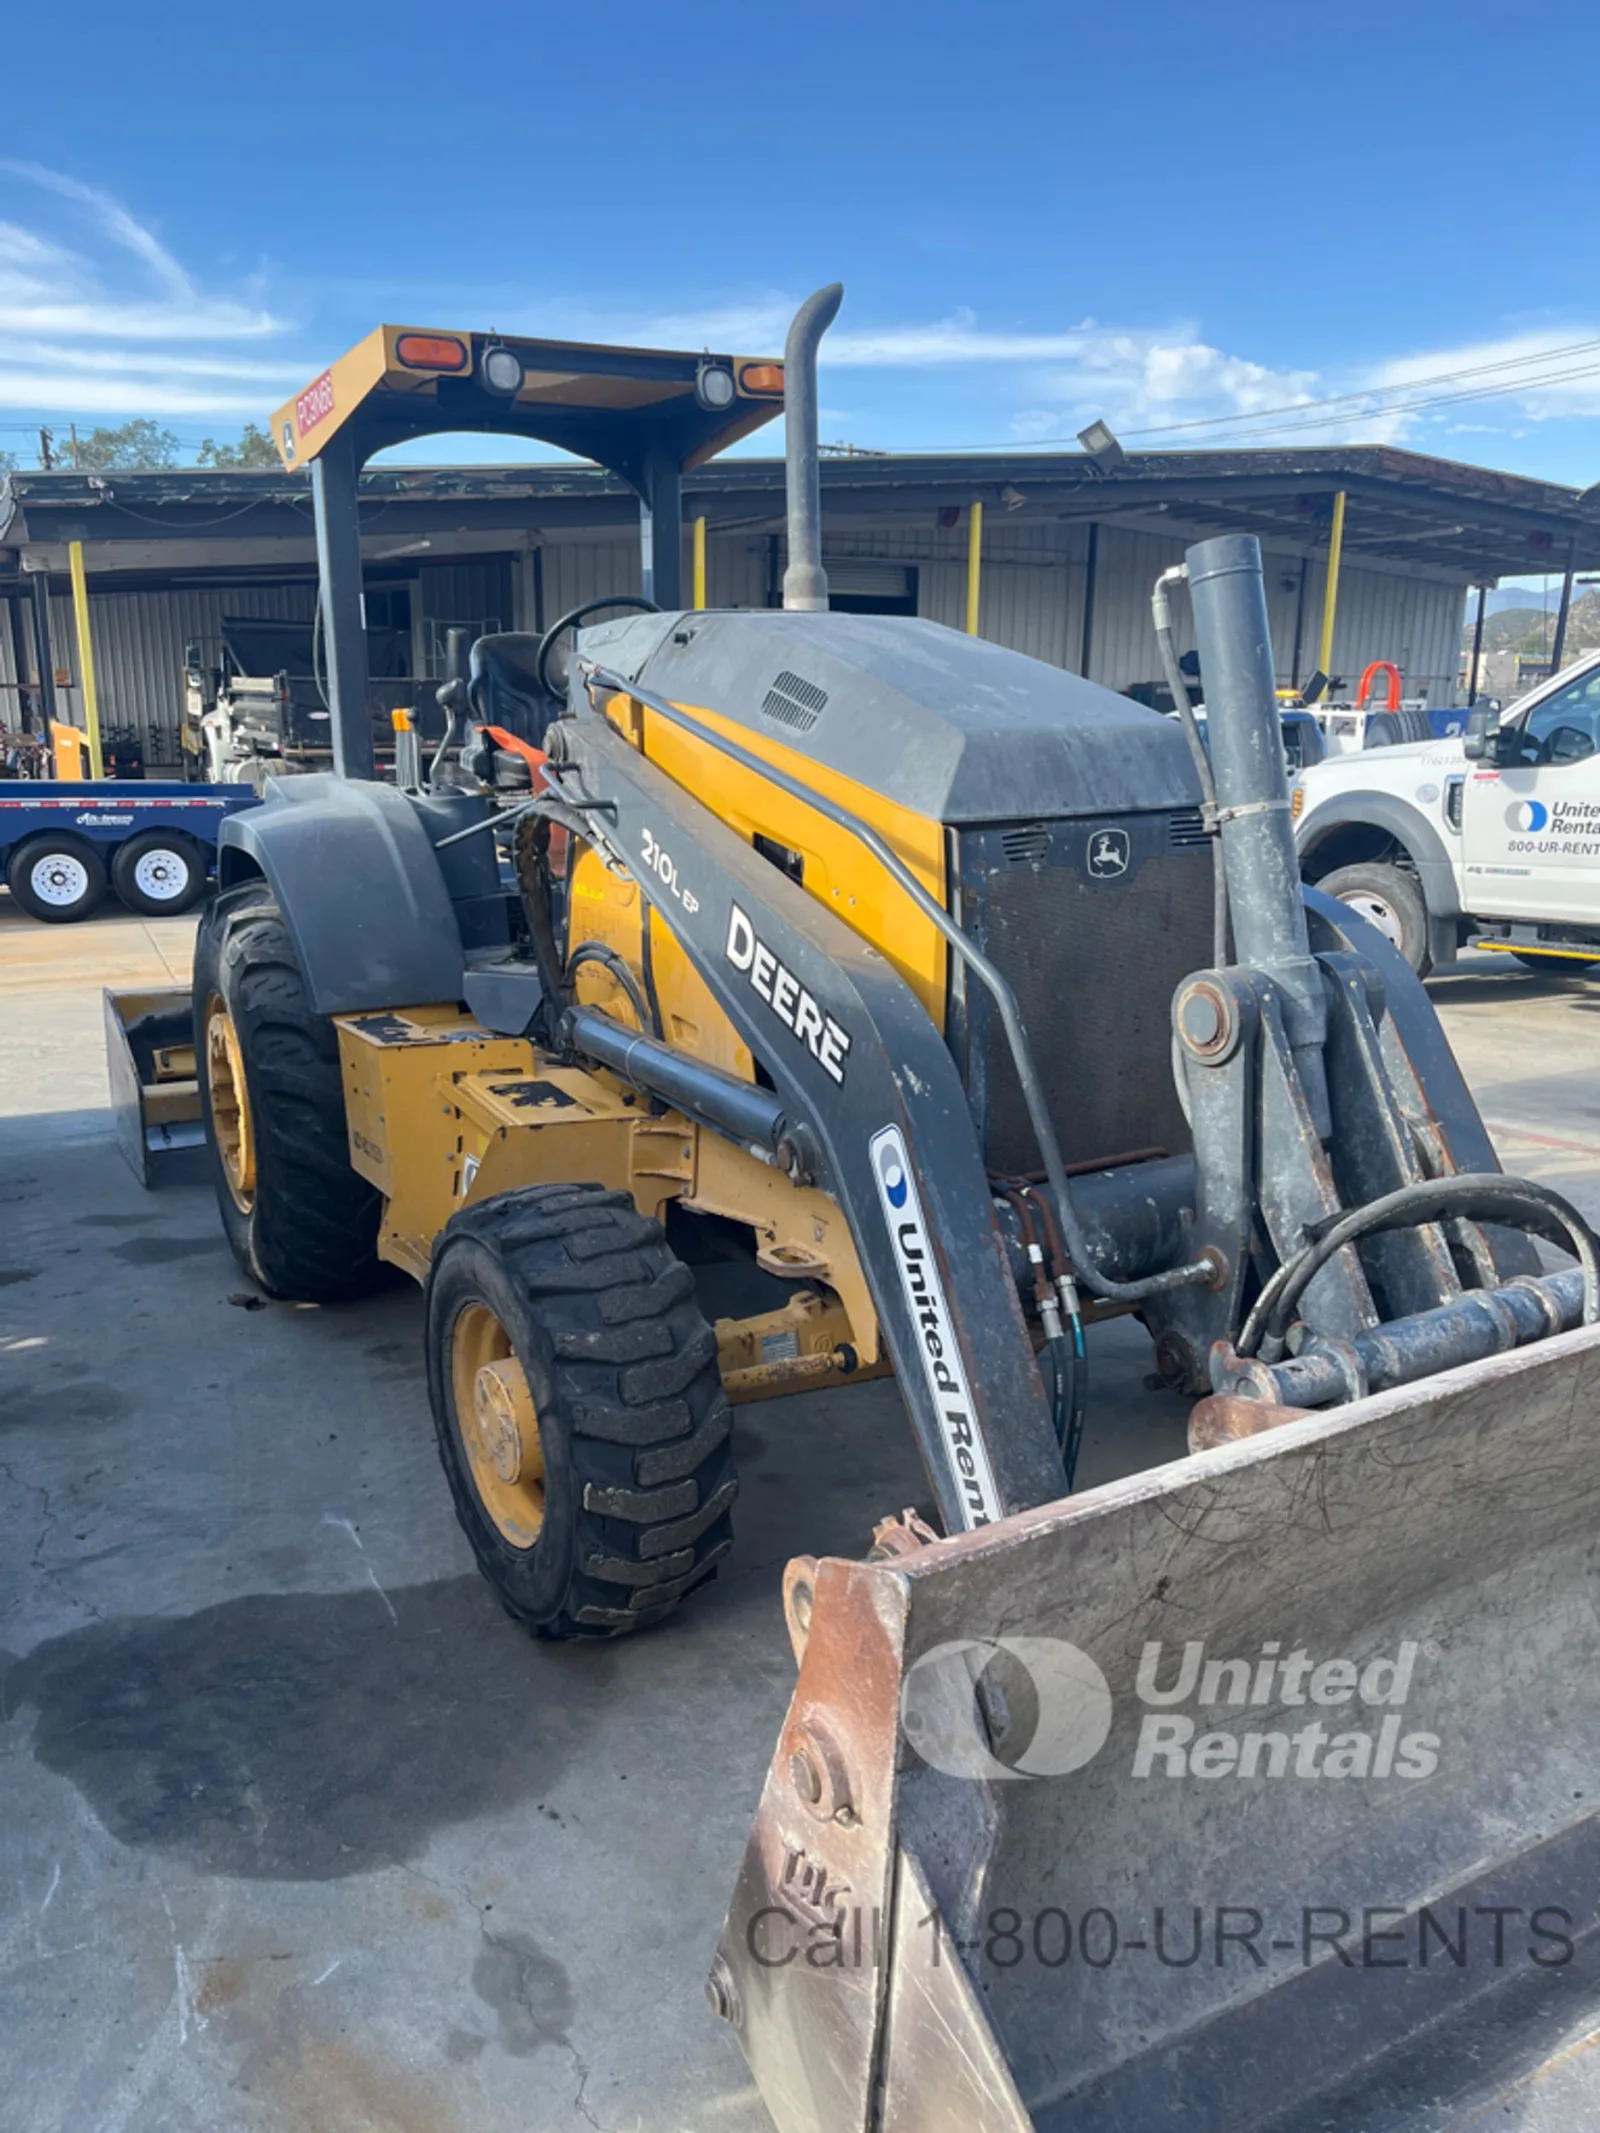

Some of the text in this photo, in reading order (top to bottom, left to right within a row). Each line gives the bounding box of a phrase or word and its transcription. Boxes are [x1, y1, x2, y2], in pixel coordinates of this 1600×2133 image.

[1552, 801, 1600, 817] Unite
[727, 903, 850, 1084] DEERE
[898, 1223, 960, 1393] United
